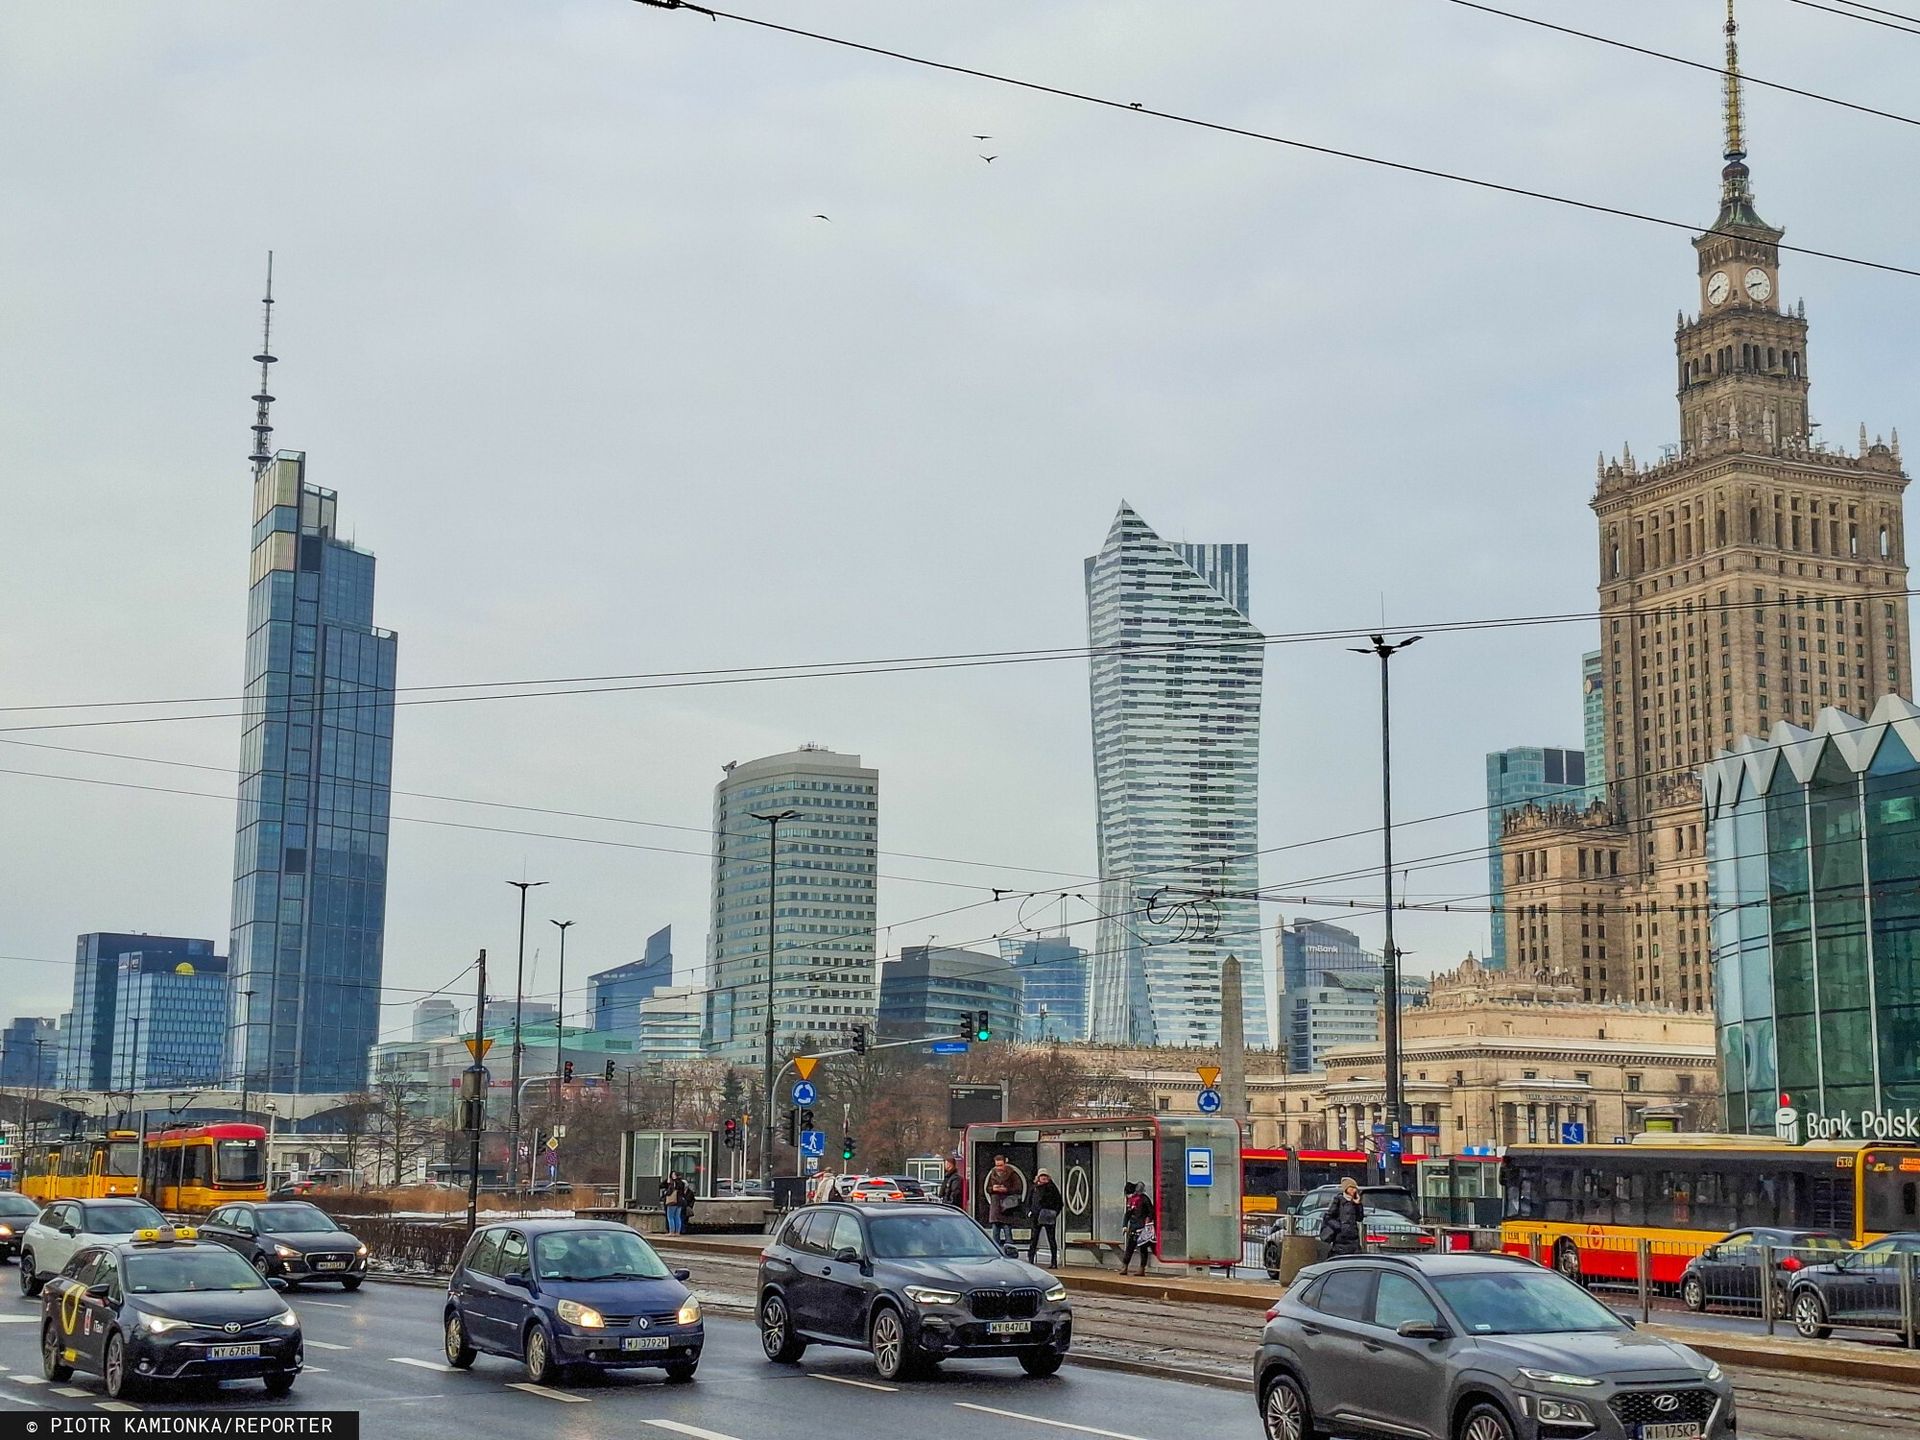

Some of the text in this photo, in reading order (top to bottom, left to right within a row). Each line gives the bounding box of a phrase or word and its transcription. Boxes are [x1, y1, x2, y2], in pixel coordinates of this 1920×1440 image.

[1307, 944, 1338, 954] mBank
[1374, 984, 1426, 996] acnture
[1807, 1108, 1920, 1139] Bank Polsk
[213, 1348, 227, 1358] WY
[1645, 1423, 1697, 1439] WI 175KP
